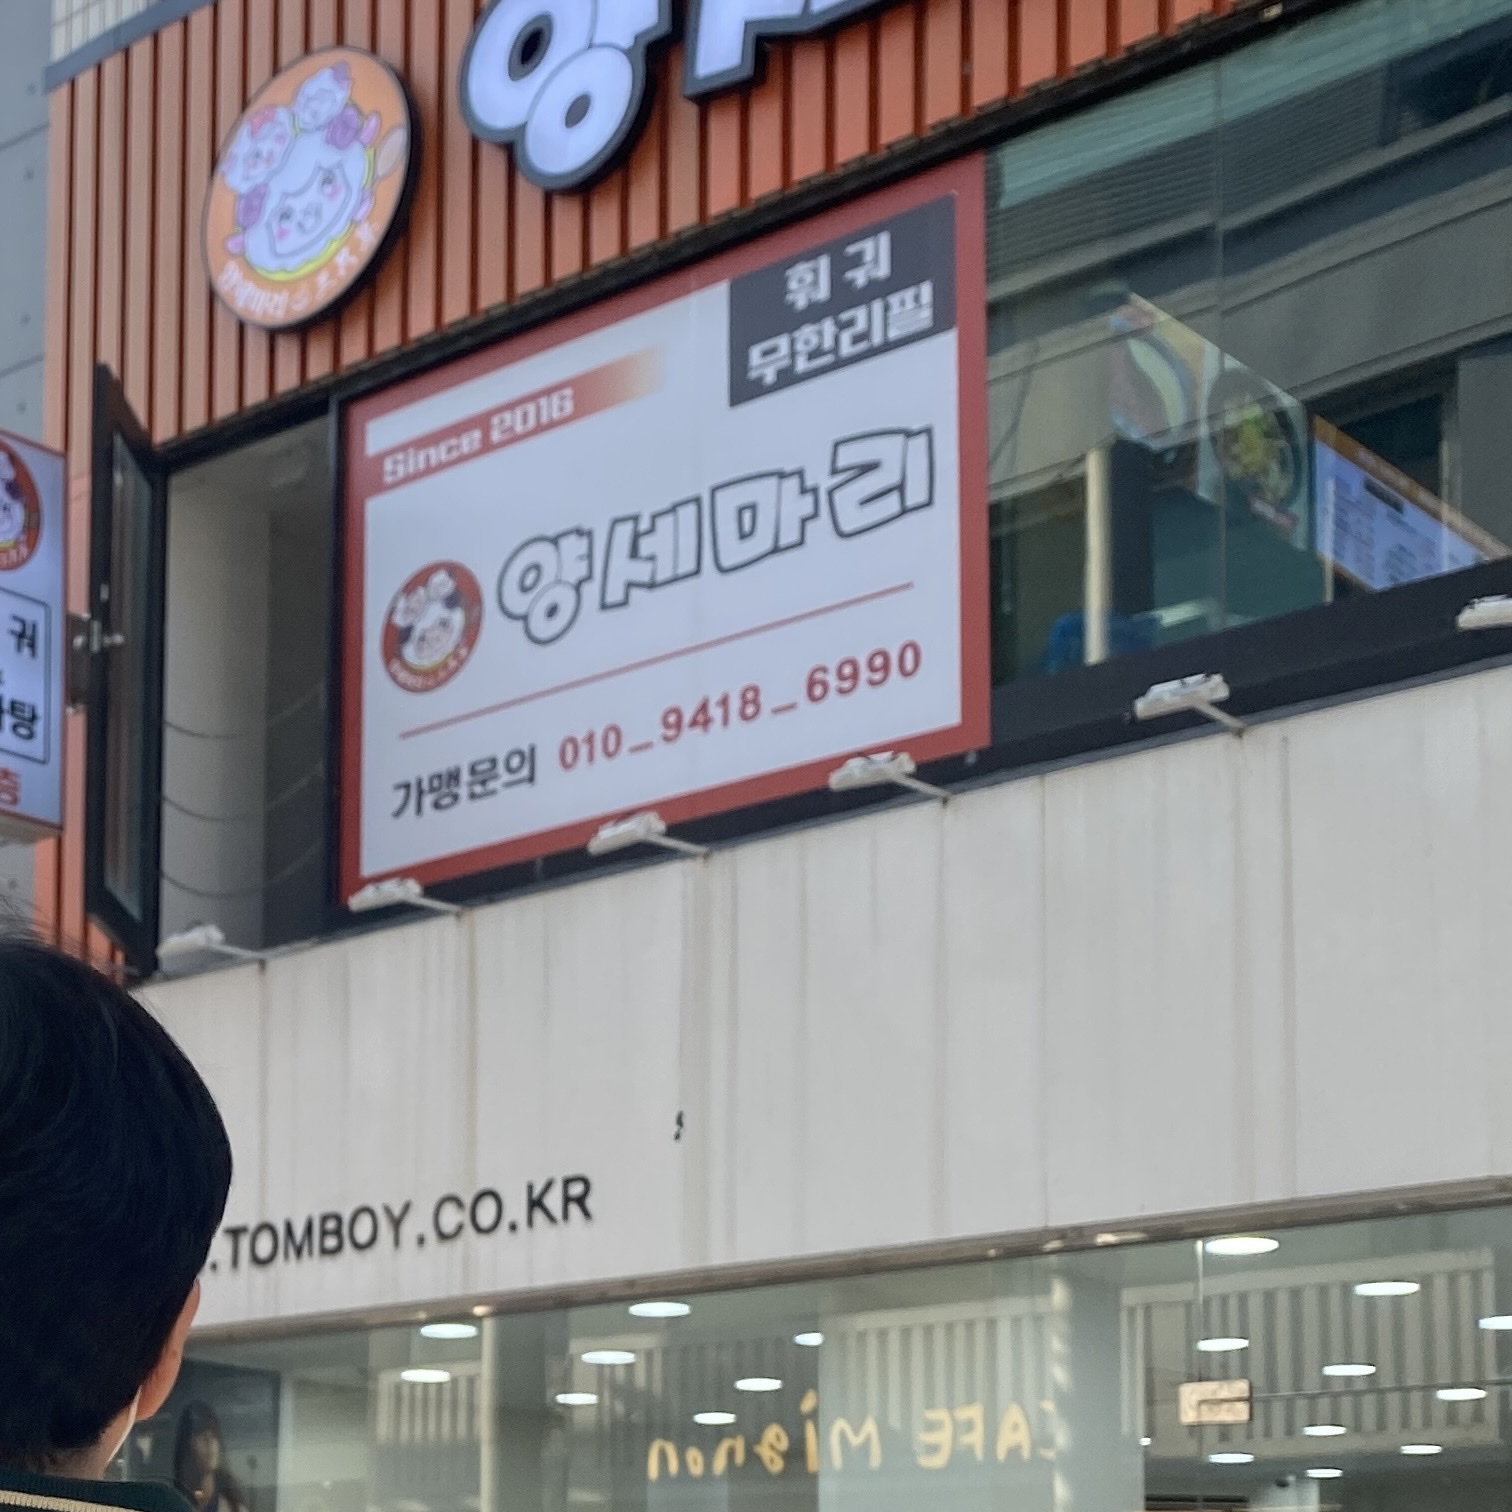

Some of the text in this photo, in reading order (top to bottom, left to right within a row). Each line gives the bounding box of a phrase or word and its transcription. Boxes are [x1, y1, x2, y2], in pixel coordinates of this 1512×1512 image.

[747, 279, 934, 386] 무한리필
[382, 386, 575, 484] Since 2016
[497, 424, 935, 646] 양세마리
[391, 743, 537, 819] 가맹문의
